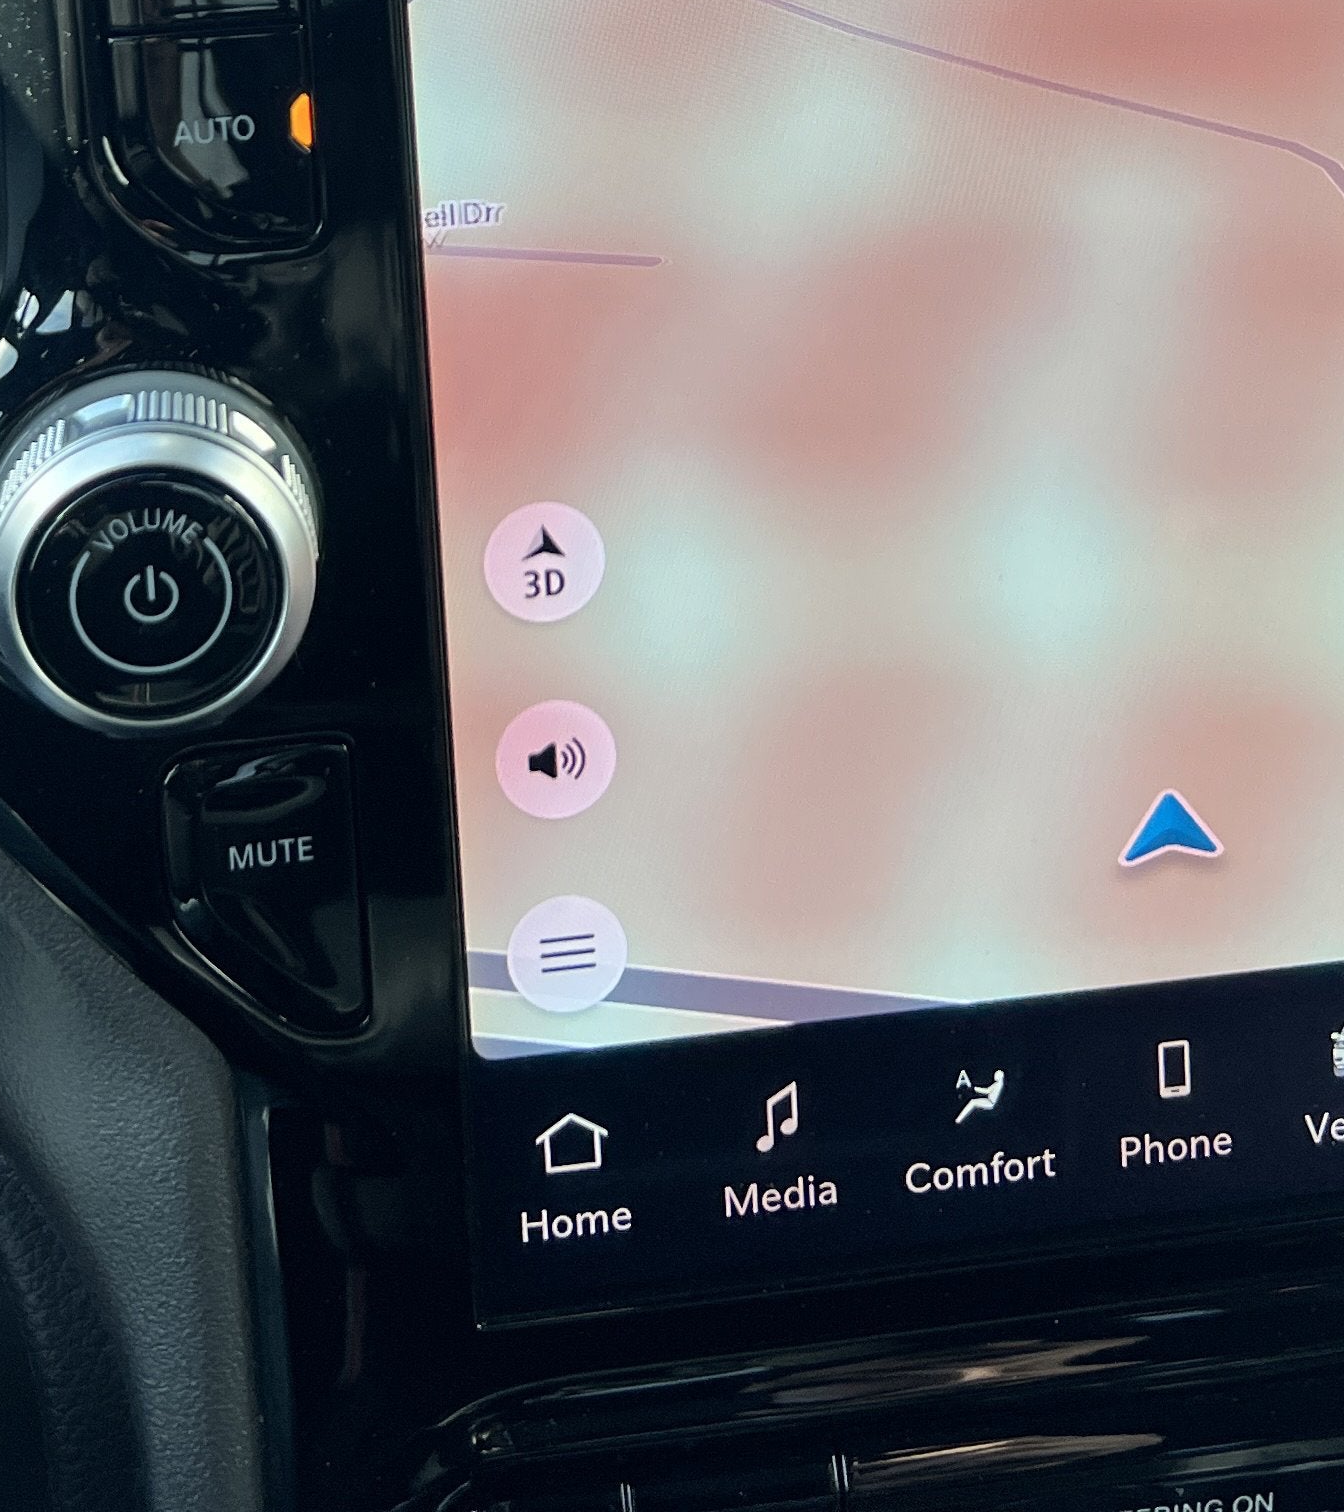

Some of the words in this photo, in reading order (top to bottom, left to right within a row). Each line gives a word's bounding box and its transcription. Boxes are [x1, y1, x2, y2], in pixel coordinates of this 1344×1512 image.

[173, 114, 256, 147] AUTO
[94, 508, 206, 553] VOLUME
[523, 568, 566, 599] 3D
[229, 835, 316, 872] MUTE
[1120, 1130, 1233, 1167] Phone
[905, 1149, 1056, 1194] Comfort
[724, 1175, 838, 1218] Media
[520, 1203, 633, 1244] Home
[1232, 1491, 1274, 1512] ON
